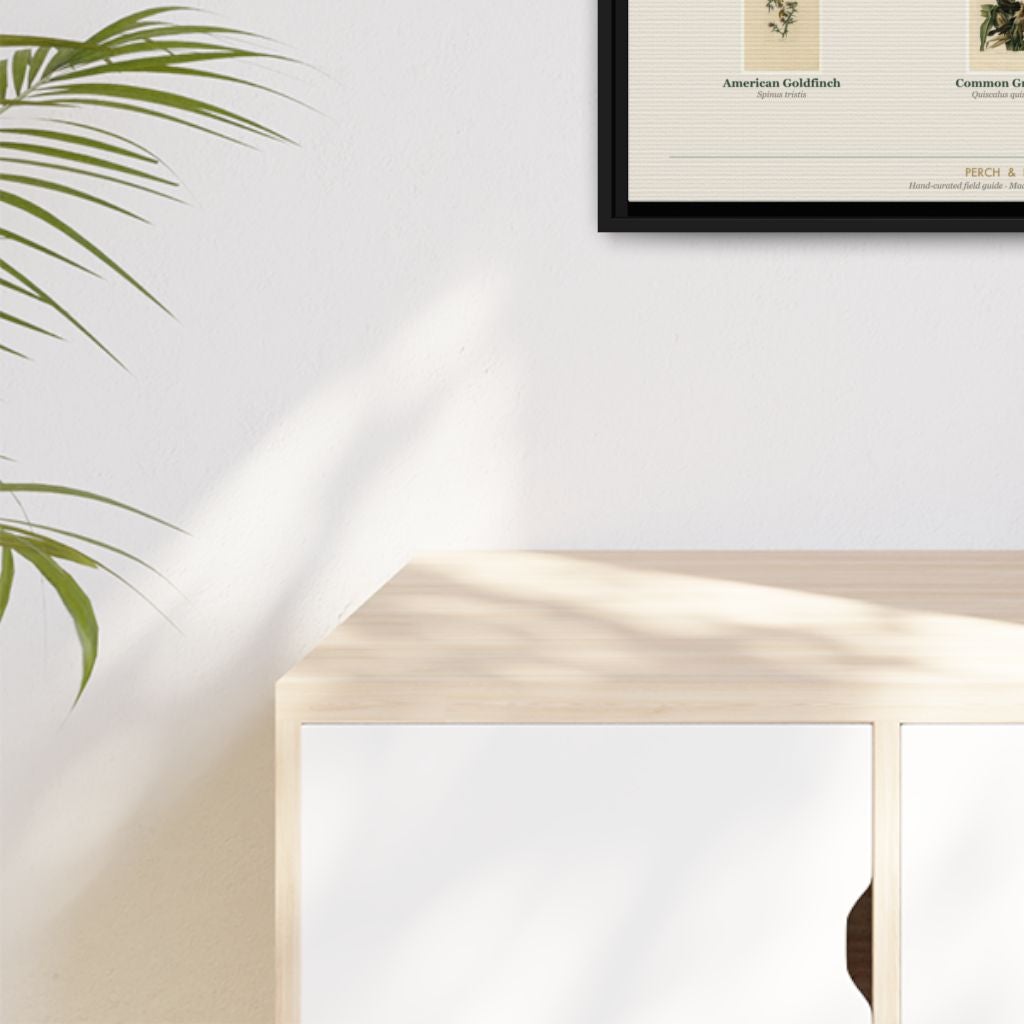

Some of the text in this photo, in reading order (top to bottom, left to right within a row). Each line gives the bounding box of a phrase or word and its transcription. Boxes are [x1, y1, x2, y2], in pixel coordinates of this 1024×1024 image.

[723, 77, 841, 88] American Goldfinch
[955, 78, 1009, 88] Common
[965, 167, 1001, 177] PERCH
[1007, 167, 1016, 177] &
[908, 181, 963, 190] Hand-curated
[962, 181, 982, 192] field
[981, 181, 1004, 192] guide
